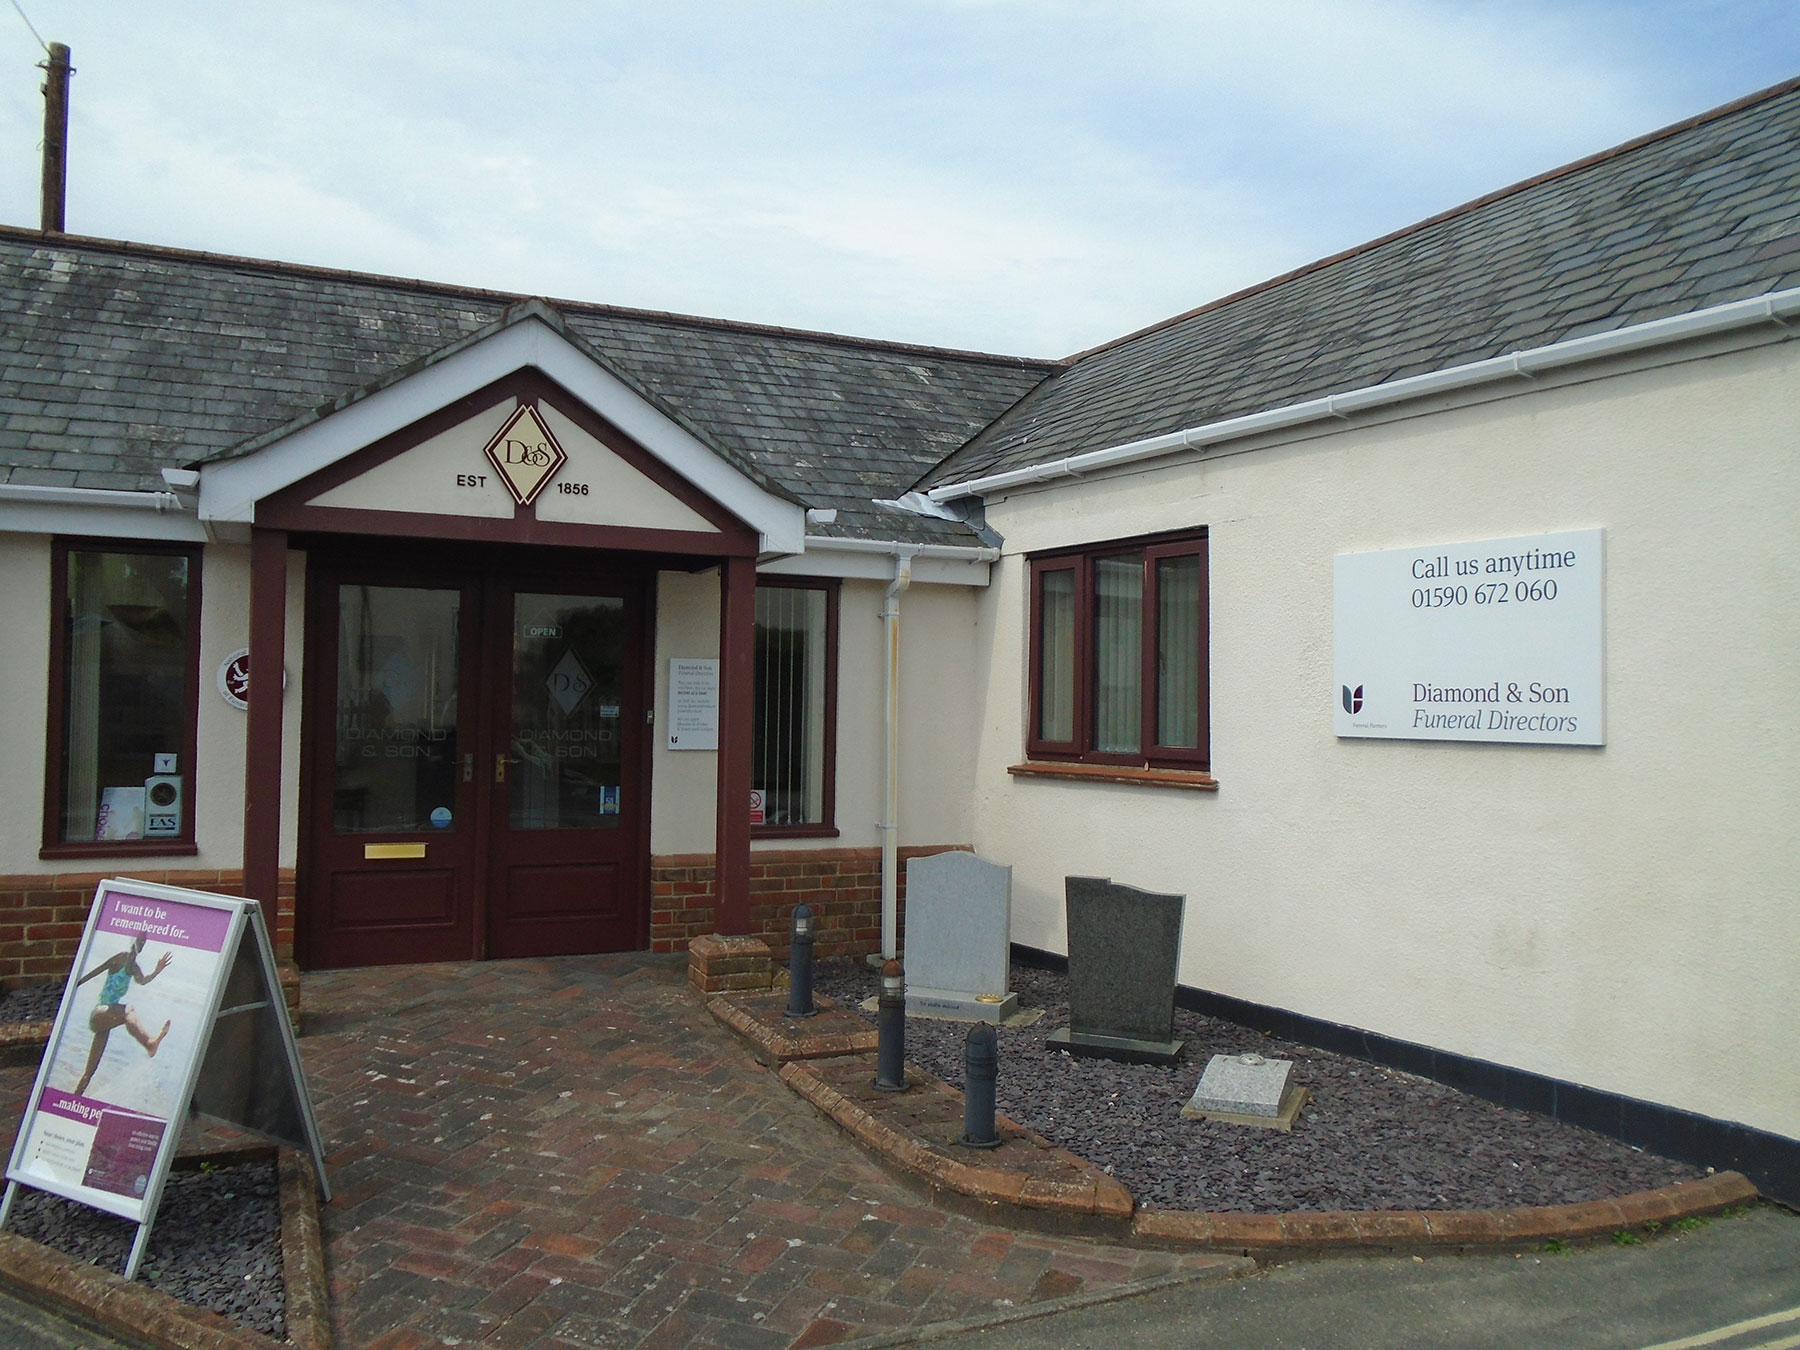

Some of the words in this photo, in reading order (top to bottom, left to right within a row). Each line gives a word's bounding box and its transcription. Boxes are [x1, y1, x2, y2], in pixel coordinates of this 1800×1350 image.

[456, 474, 487, 488] EST
[557, 482, 589, 496] 1856
[1411, 556, 1449, 580] Call
[1455, 559, 1479, 576] us
[1485, 549, 1576, 577] anytime
[1411, 585, 1468, 608] 01590
[1474, 582, 1509, 605] 672
[1515, 579, 1558, 602] 060
[530, 627, 556, 637] OPEN
[1412, 682, 1500, 704] Diamond
[1506, 682, 1523, 703] &
[1528, 682, 1570, 703] Son
[1412, 709, 1482, 730] Funeral
[1488, 710, 1578, 733] Directors
[346, 728, 447, 741] DIAMOND
[519, 729, 613, 742] DIAMOND
[361, 745, 376, 757] &
[385, 745, 431, 758] SON
[555, 745, 598, 758] SON
[114, 900, 121, 912] I
[121, 903, 142, 917] want
[143, 907, 154, 918] to
[154, 907, 167, 920] be
[110, 917, 169, 935] remembered
[89, 1108, 101, 1120] pe
